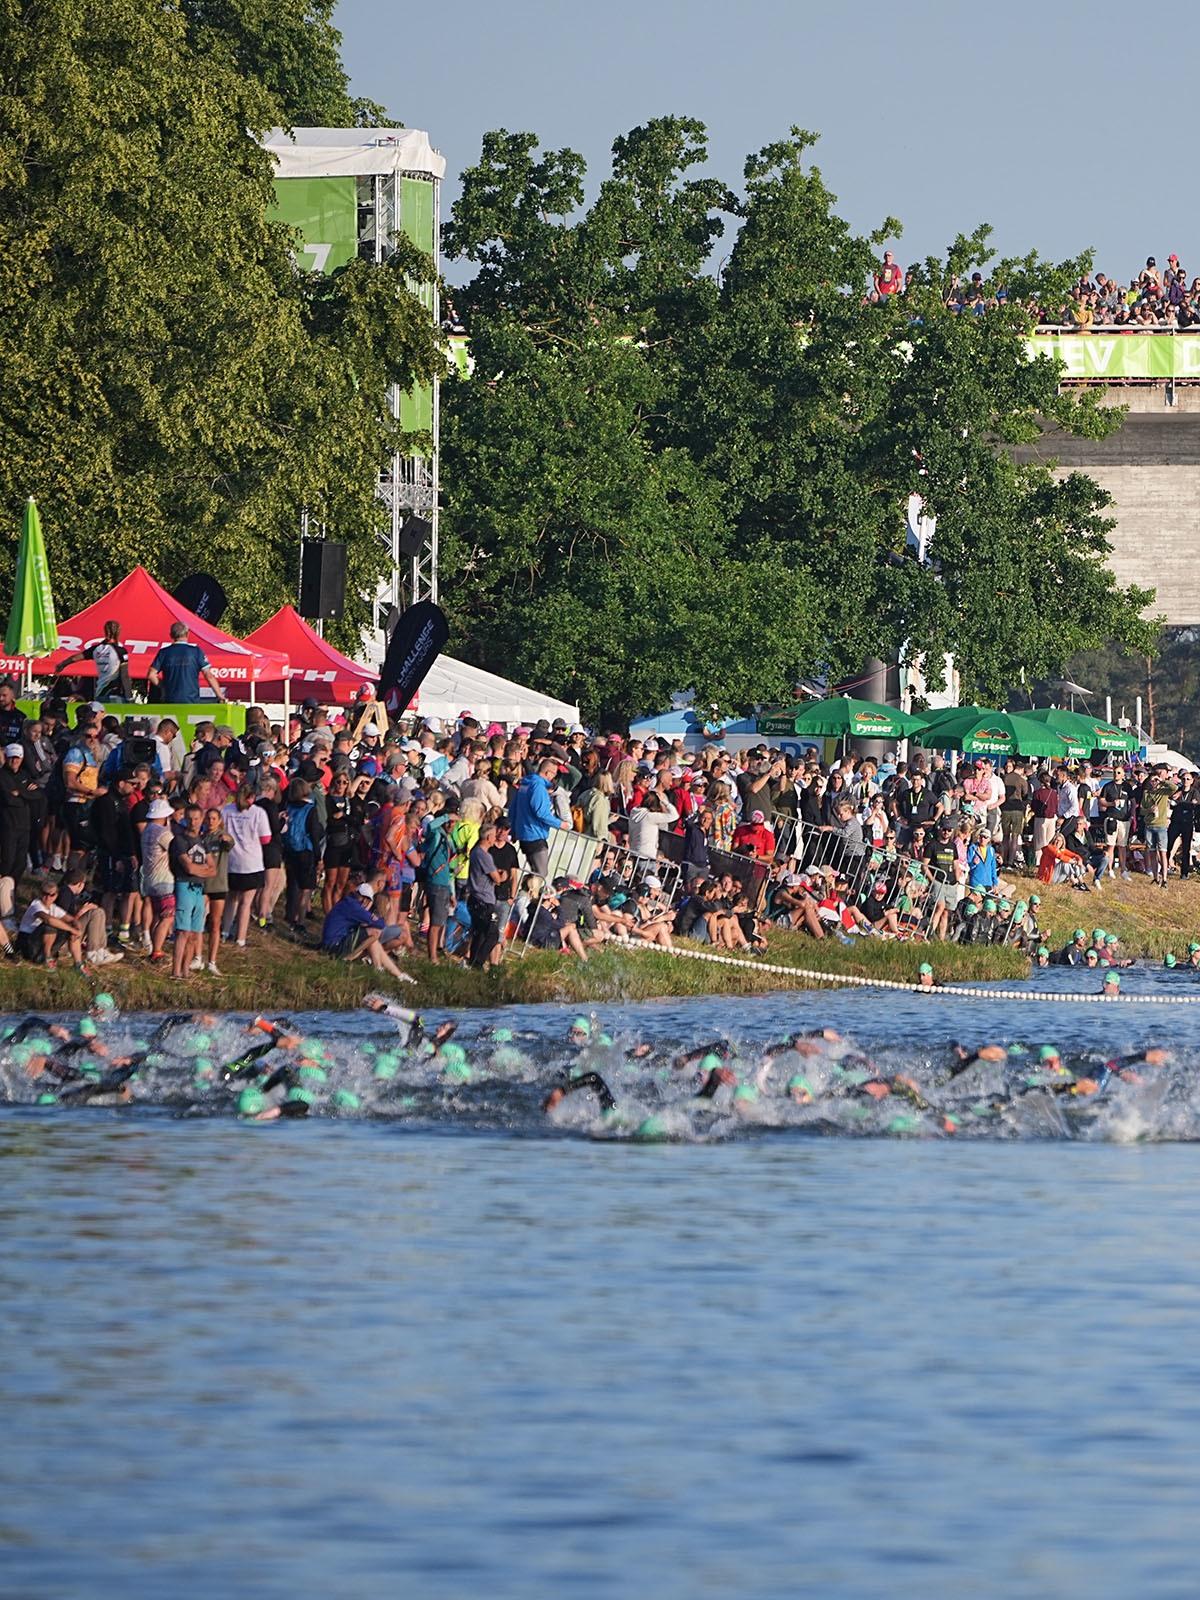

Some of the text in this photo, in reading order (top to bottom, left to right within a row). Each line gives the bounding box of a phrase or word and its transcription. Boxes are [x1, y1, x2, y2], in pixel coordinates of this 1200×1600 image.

[210, 667, 247, 679] ROTH
[765, 721, 792, 731] Pyraser
[856, 723, 893, 733] Pyraser
[972, 741, 1012, 751] Pyraser
